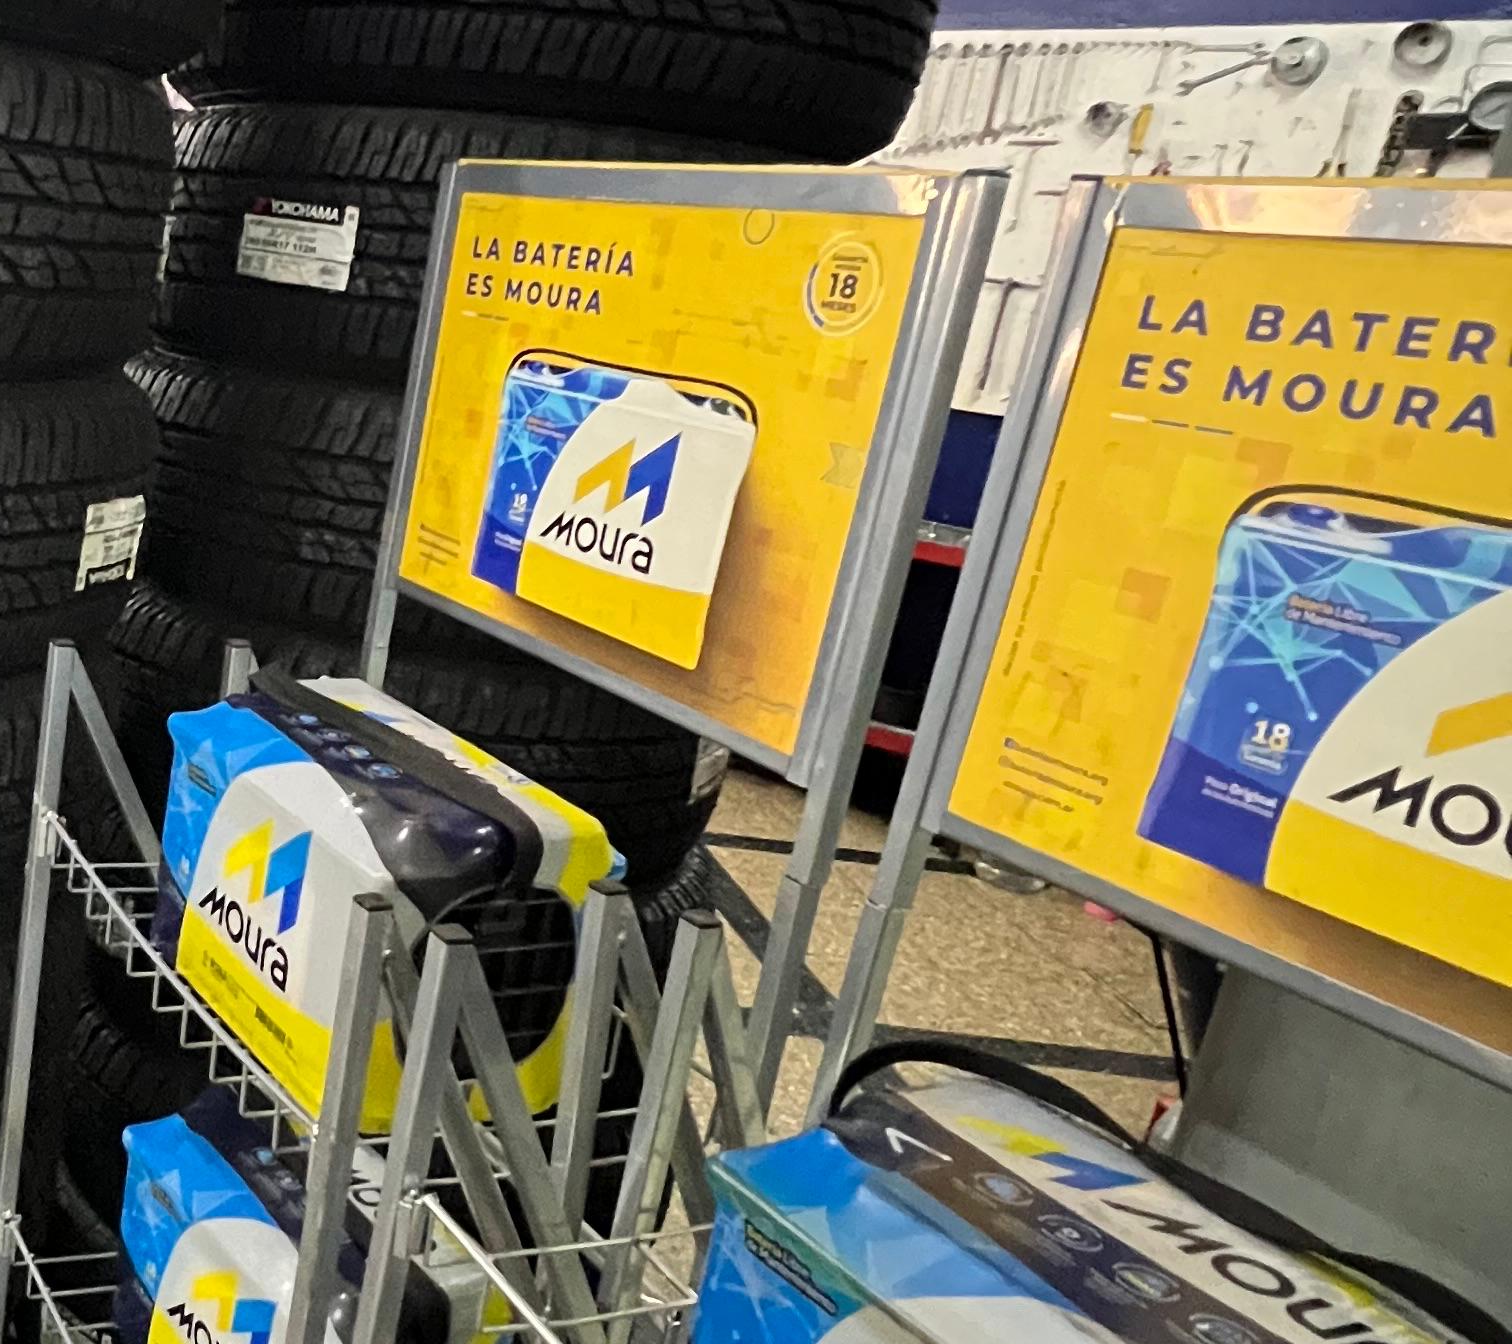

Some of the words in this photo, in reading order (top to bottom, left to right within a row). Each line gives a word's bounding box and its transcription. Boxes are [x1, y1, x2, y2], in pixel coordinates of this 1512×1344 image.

[271, 198, 339, 222] YOKOHAMA
[472, 236, 500, 261] LA
[513, 240, 633, 277] BATERÍA
[466, 273, 494, 297] ES
[504, 278, 601, 315] MOURA
[829, 272, 858, 299] 18
[1138, 294, 1208, 336] LA
[1245, 303, 1512, 368] BATER
[1121, 353, 1192, 395] ES
[1222, 365, 1497, 438] MOURA
[1251, 720, 1291, 753] 18
